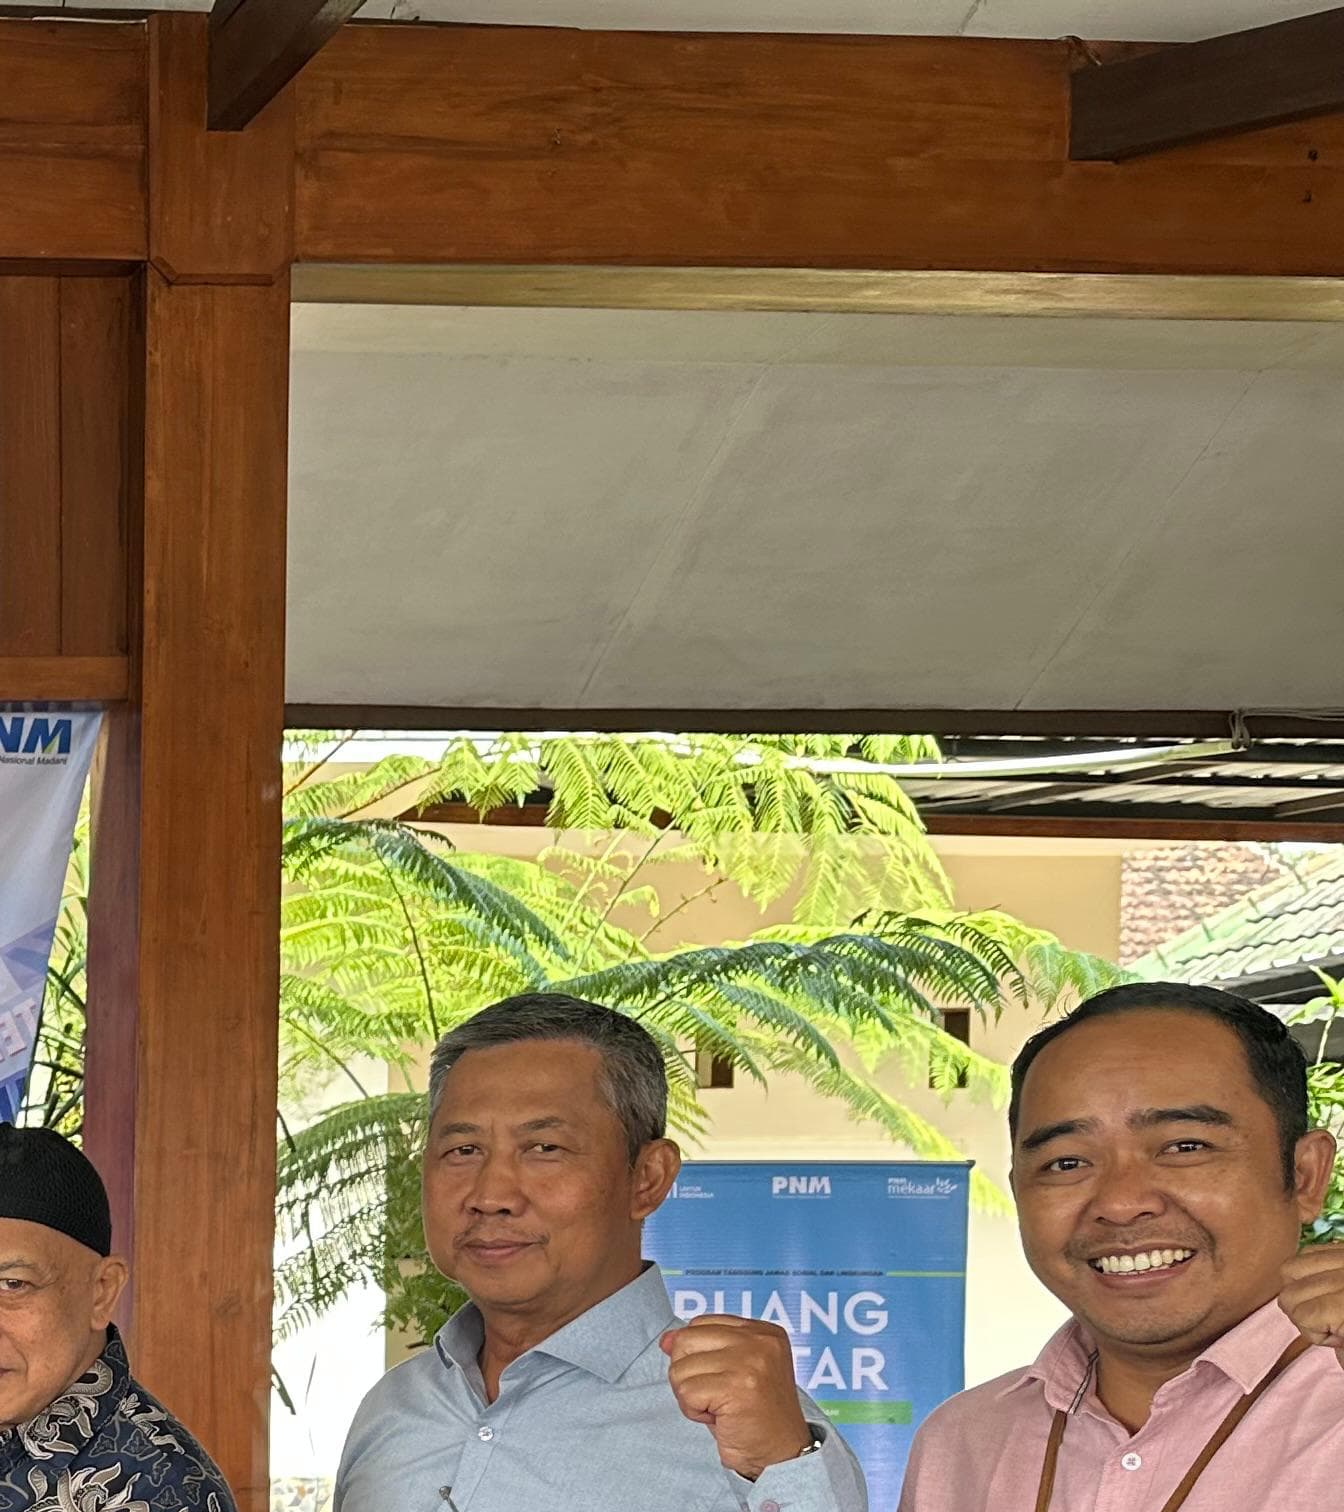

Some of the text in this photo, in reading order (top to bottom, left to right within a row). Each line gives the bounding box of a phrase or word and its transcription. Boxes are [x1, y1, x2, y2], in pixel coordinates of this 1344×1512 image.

[37, 756, 67, 766] Madani
[771, 1176, 831, 1194] PNM
[888, 1182, 935, 1195] mekaar
